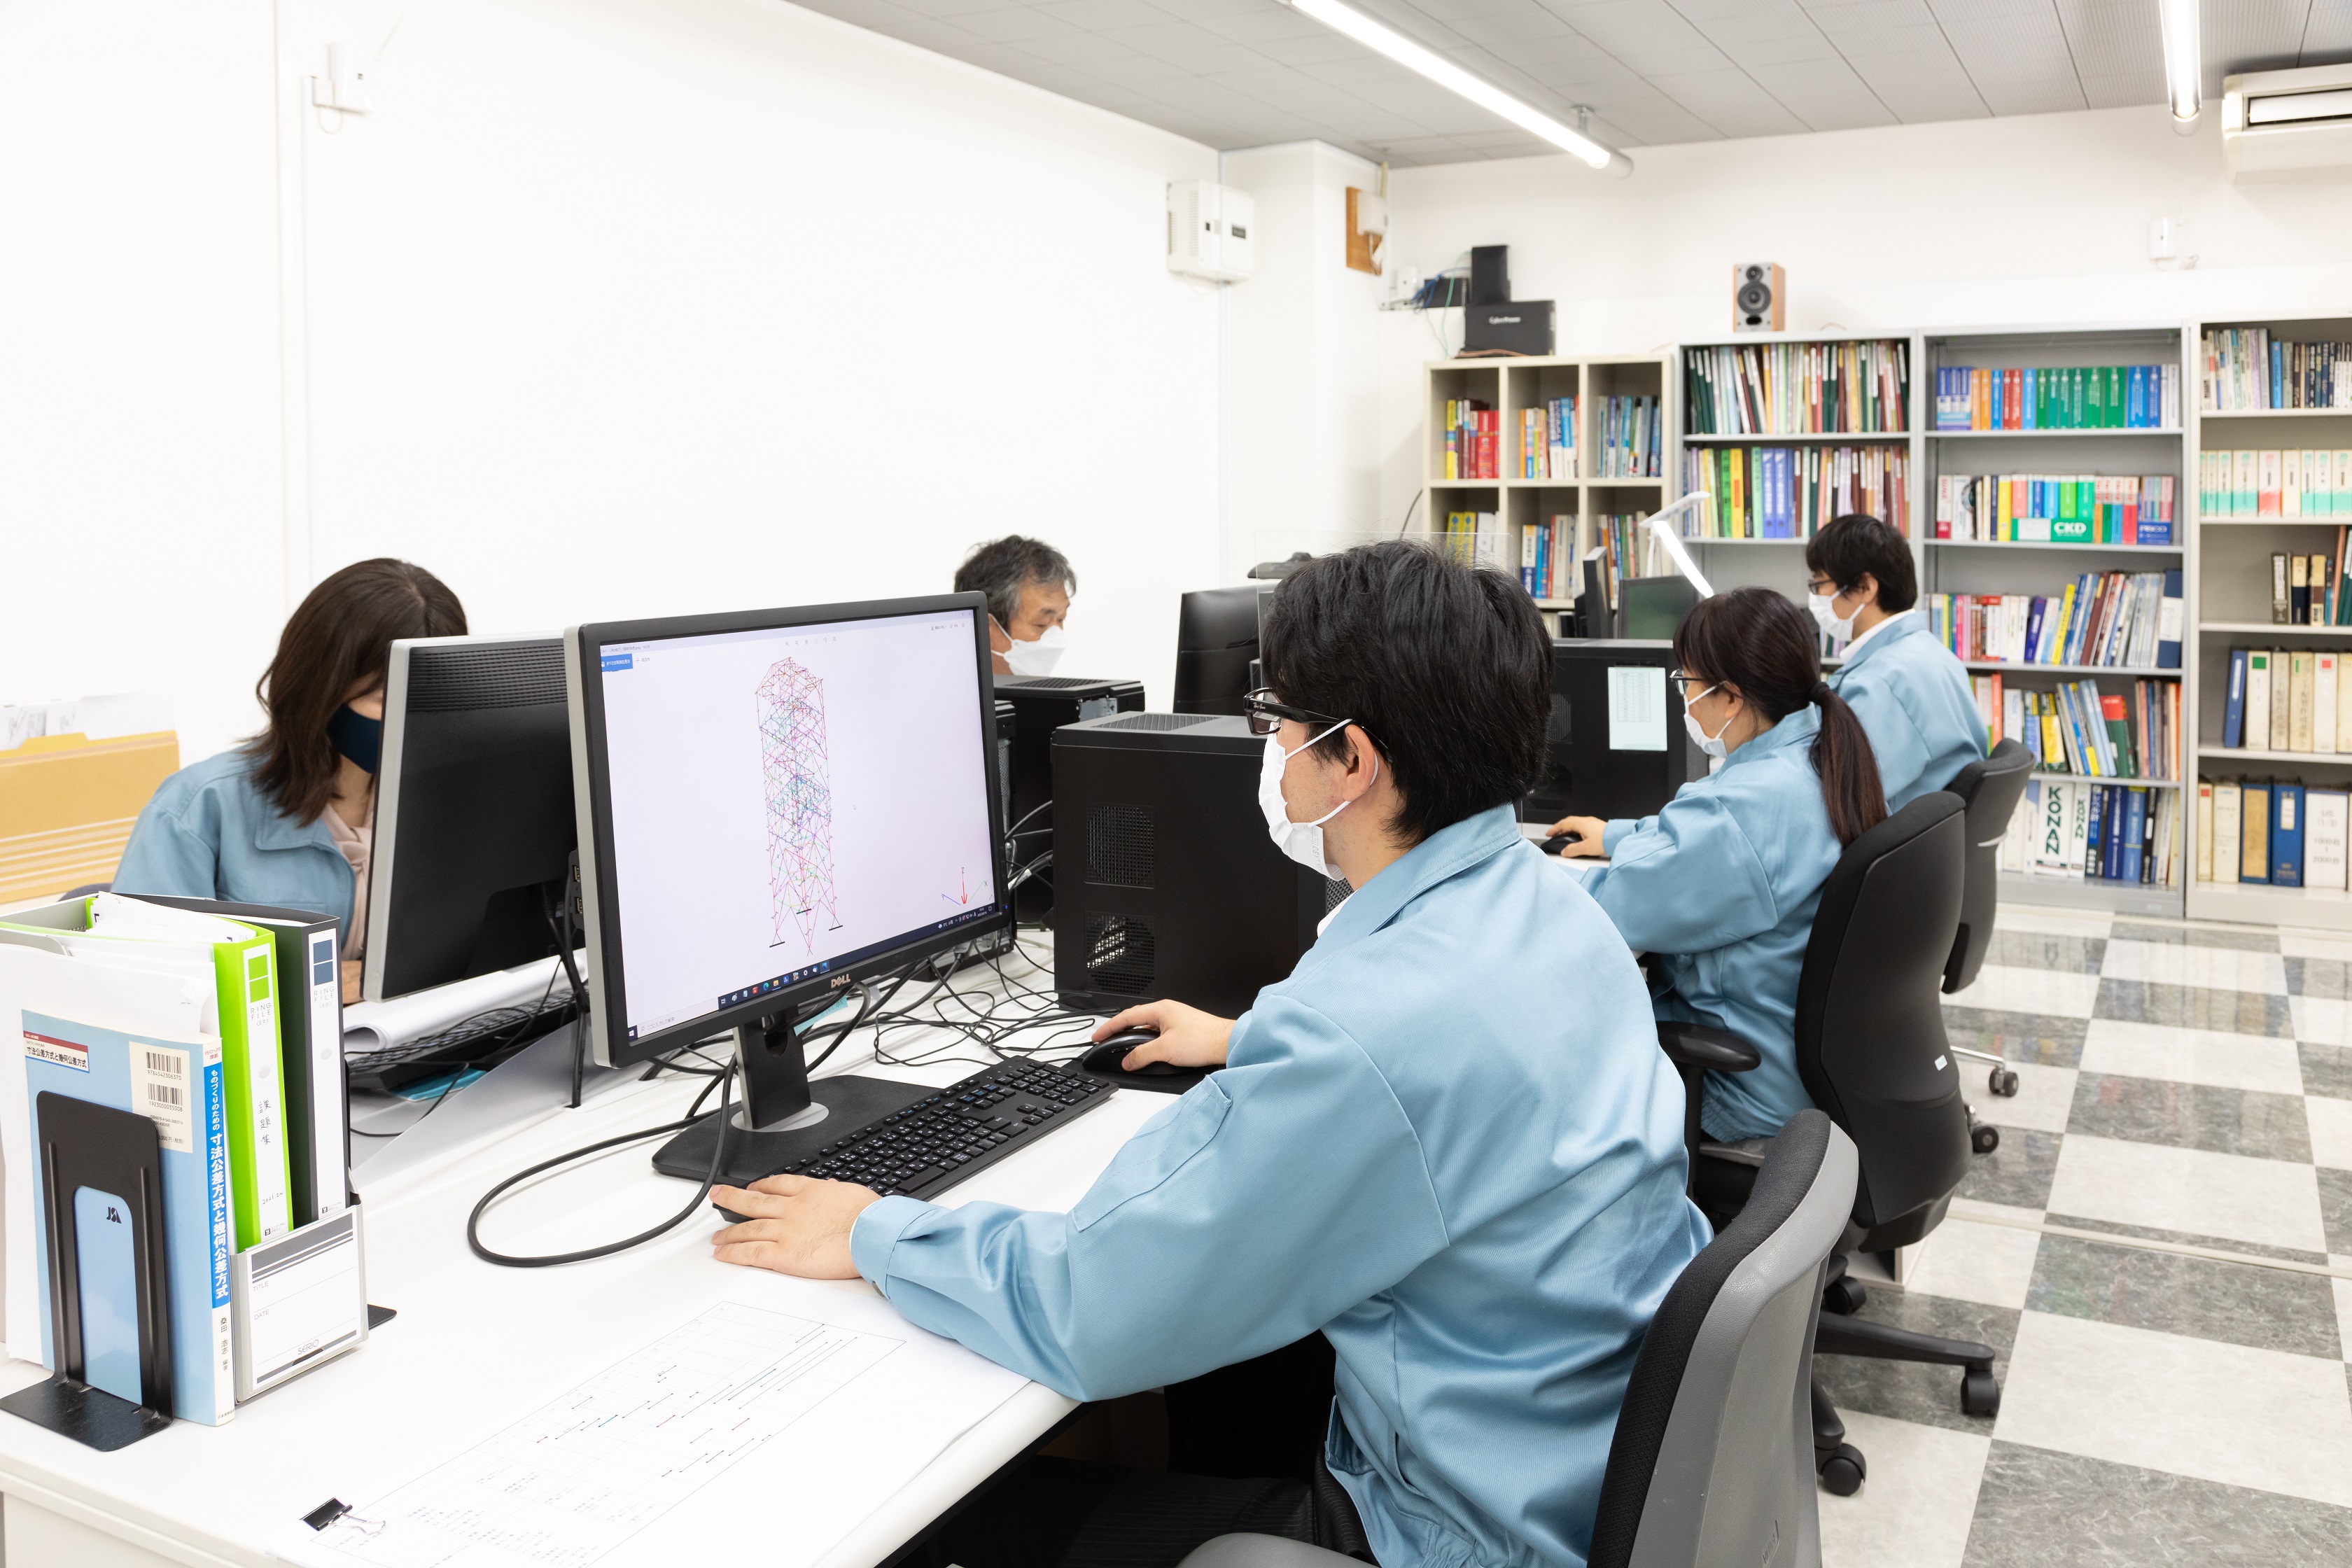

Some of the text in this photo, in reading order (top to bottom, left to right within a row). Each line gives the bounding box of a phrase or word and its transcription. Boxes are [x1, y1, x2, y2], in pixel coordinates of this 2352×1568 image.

[2053, 522, 2087, 535] CKD
[2045, 785, 2063, 855] KONAN
[2075, 798, 2085, 839] KONAN
[831, 973, 850, 989] DELL
[314, 986, 335, 996] RING
[314, 993, 335, 1002] FILE
[250, 1002, 272, 1014] RING
[251, 1009, 272, 1021] FILE
[147, 1069, 182, 1081] 9784542306370
[148, 1100, 183, 1112] 1923050035008
[210, 1069, 229, 1300] ものづくりのための 寸法公差方式と幾何公差方式
[253, 1280, 269, 1292] TITLE
[254, 1309, 270, 1320] DATE
[298, 1339, 319, 1355] SERIO
